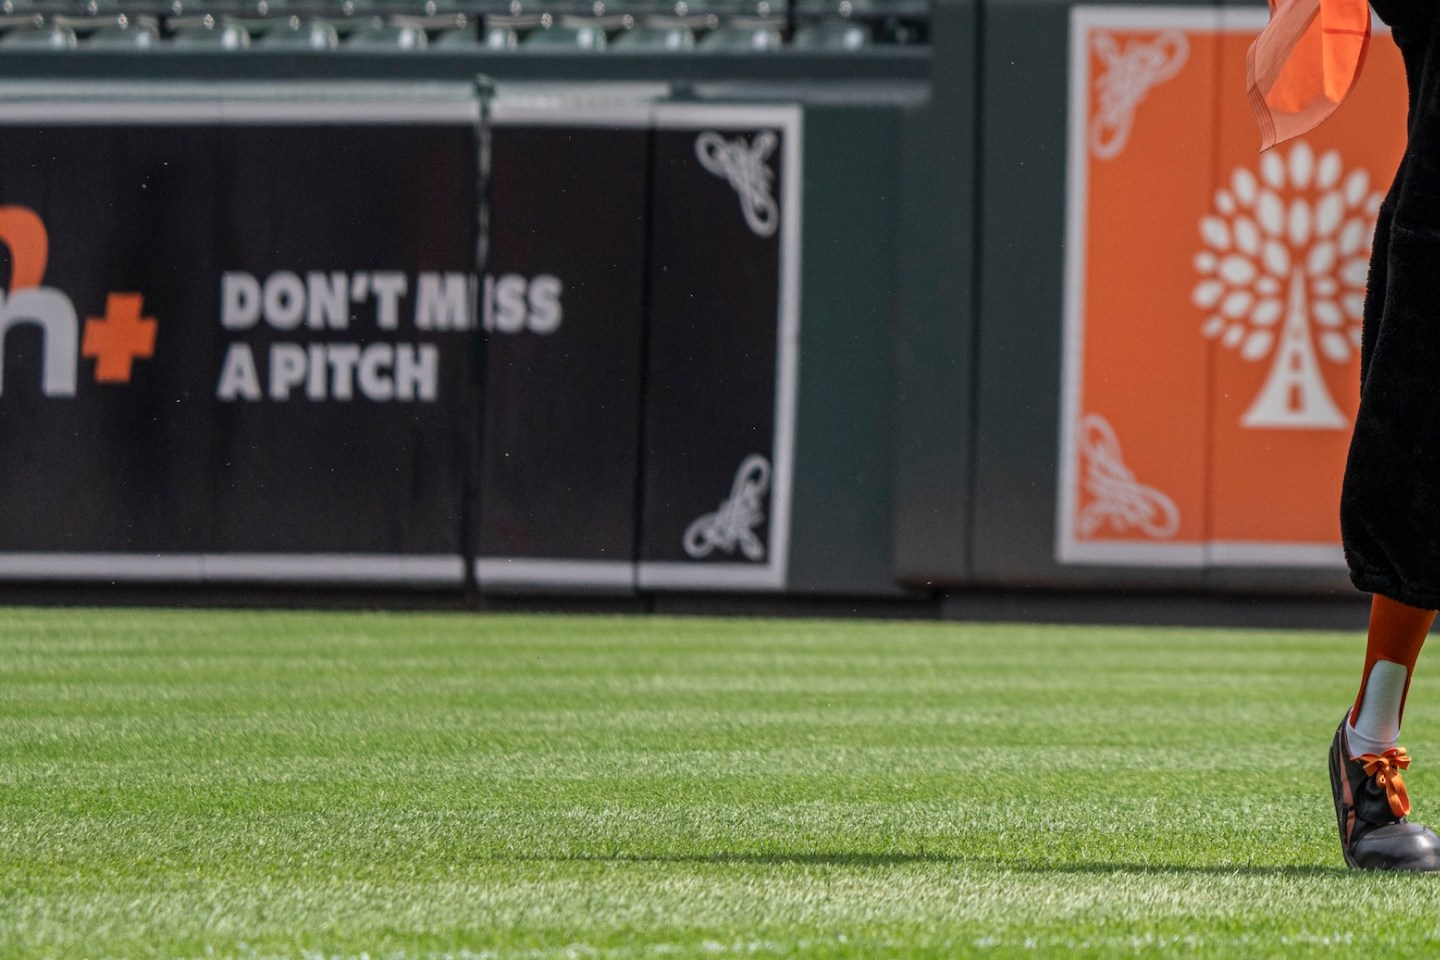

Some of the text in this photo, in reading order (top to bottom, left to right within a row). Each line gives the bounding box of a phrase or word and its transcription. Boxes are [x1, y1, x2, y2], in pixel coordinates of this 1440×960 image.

[221, 271, 562, 334] DON'T MISS
[217, 342, 438, 400] A PITCH
